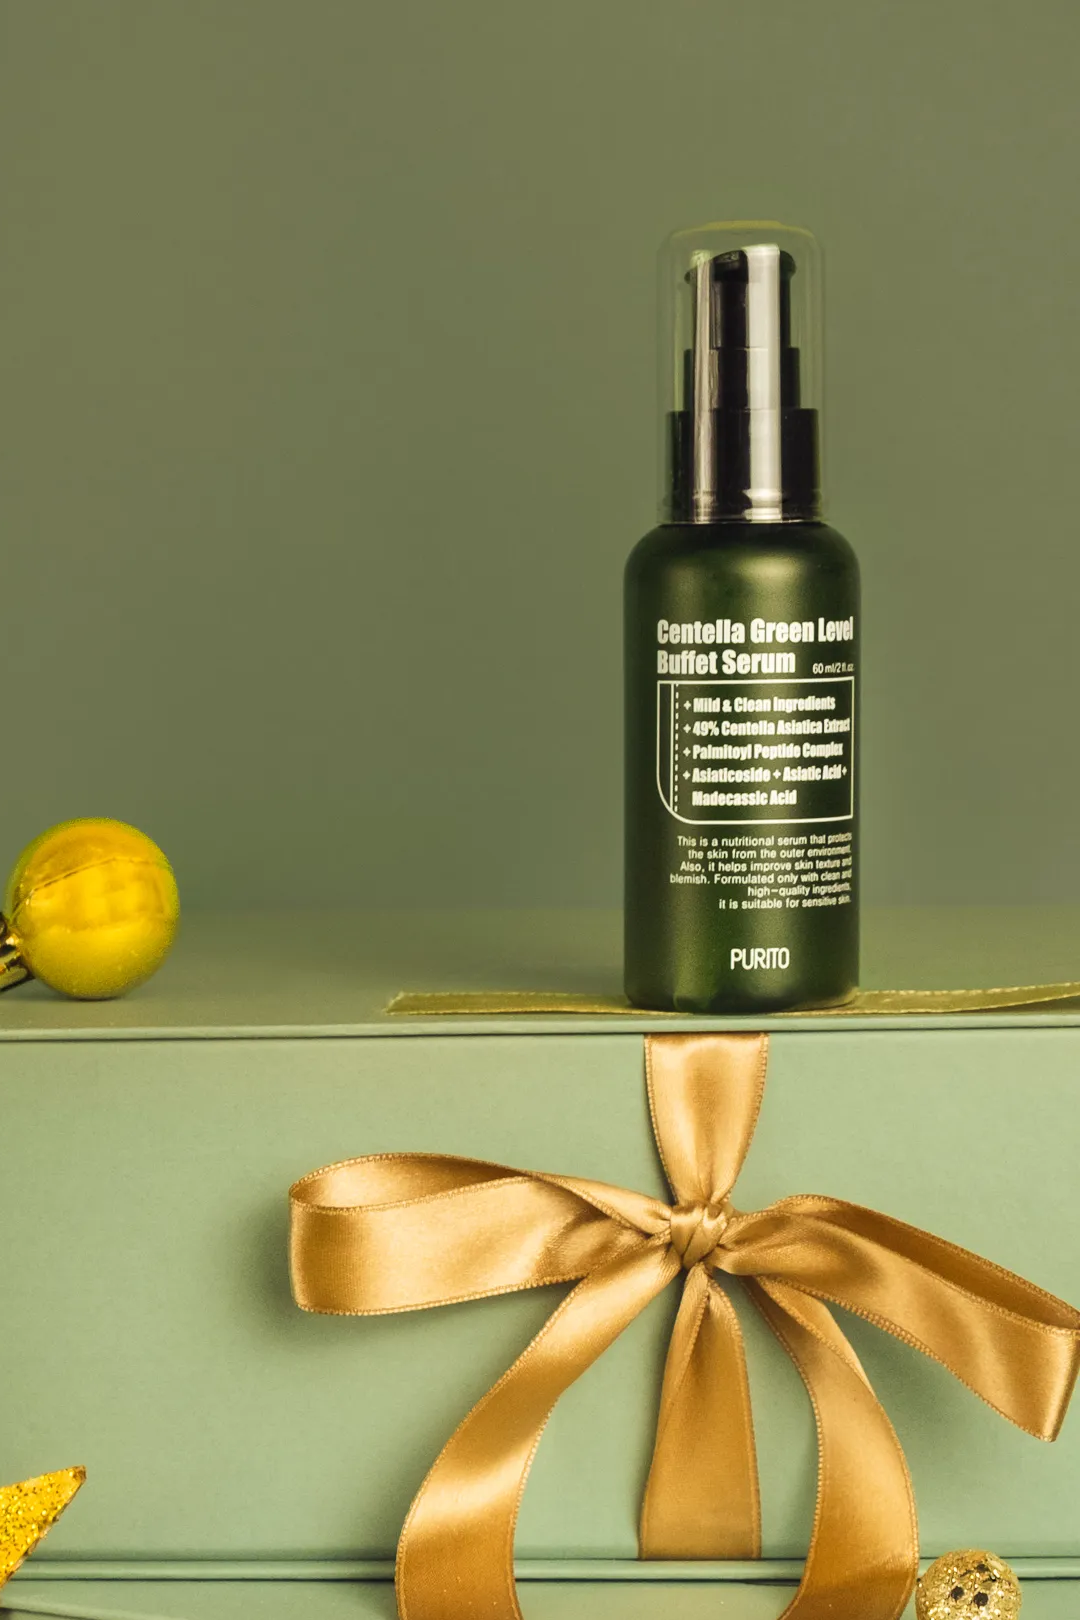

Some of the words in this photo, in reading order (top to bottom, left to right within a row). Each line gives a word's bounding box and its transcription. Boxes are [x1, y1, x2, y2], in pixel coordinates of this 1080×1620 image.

[657, 619, 745, 644] Centella
[751, 618, 814, 643] Green
[818, 616, 853, 642] Level
[657, 650, 718, 674] Buffet
[722, 650, 795, 674] Serum
[812, 662, 824, 674] 60
[694, 698, 720, 712] Mild
[722, 699, 731, 712] &
[734, 697, 770, 712] Clean
[774, 696, 835, 713] Ingredients
[693, 722, 720, 736] 49%
[722, 721, 775, 736] Centella
[777, 720, 822, 734] Asiatica
[824, 718, 850, 733] Extract
[693, 745, 752, 760] Palmitoyl
[754, 744, 800, 760] Peptide
[803, 742, 843, 758] Complex
[692, 768, 770, 783] Asiaticoside
[783, 766, 821, 782] Asiatic
[823, 765, 841, 779] Acid
[692, 791, 767, 806] Madecassic
[770, 790, 796, 805] Acid
[678, 836, 696, 847] This
[722, 836, 774, 847] nutritional
[778, 836, 806, 845] serum
[810, 835, 825, 844] that
[688, 849, 703, 859] the
[707, 849, 728, 859] skin
[732, 849, 756, 859] from
[761, 849, 776, 858] the
[780, 848, 804, 858] outer
[680, 863, 705, 873] Also,
[718, 862, 747, 873] helps
[751, 861, 791, 872] improve
[795, 861, 813, 871] skin
[670, 874, 710, 884] blemish.
[714, 873, 774, 884] Formulated
[778, 873, 798, 884] only
[801, 873, 818, 883] with
[821, 872, 840, 882] clean
[748, 886, 810, 897] high-quality
[742, 899, 782, 909] suitable
[786, 899, 799, 908] for
[802, 897, 836, 908] sensitive
[731, 948, 789, 970] PURITO
